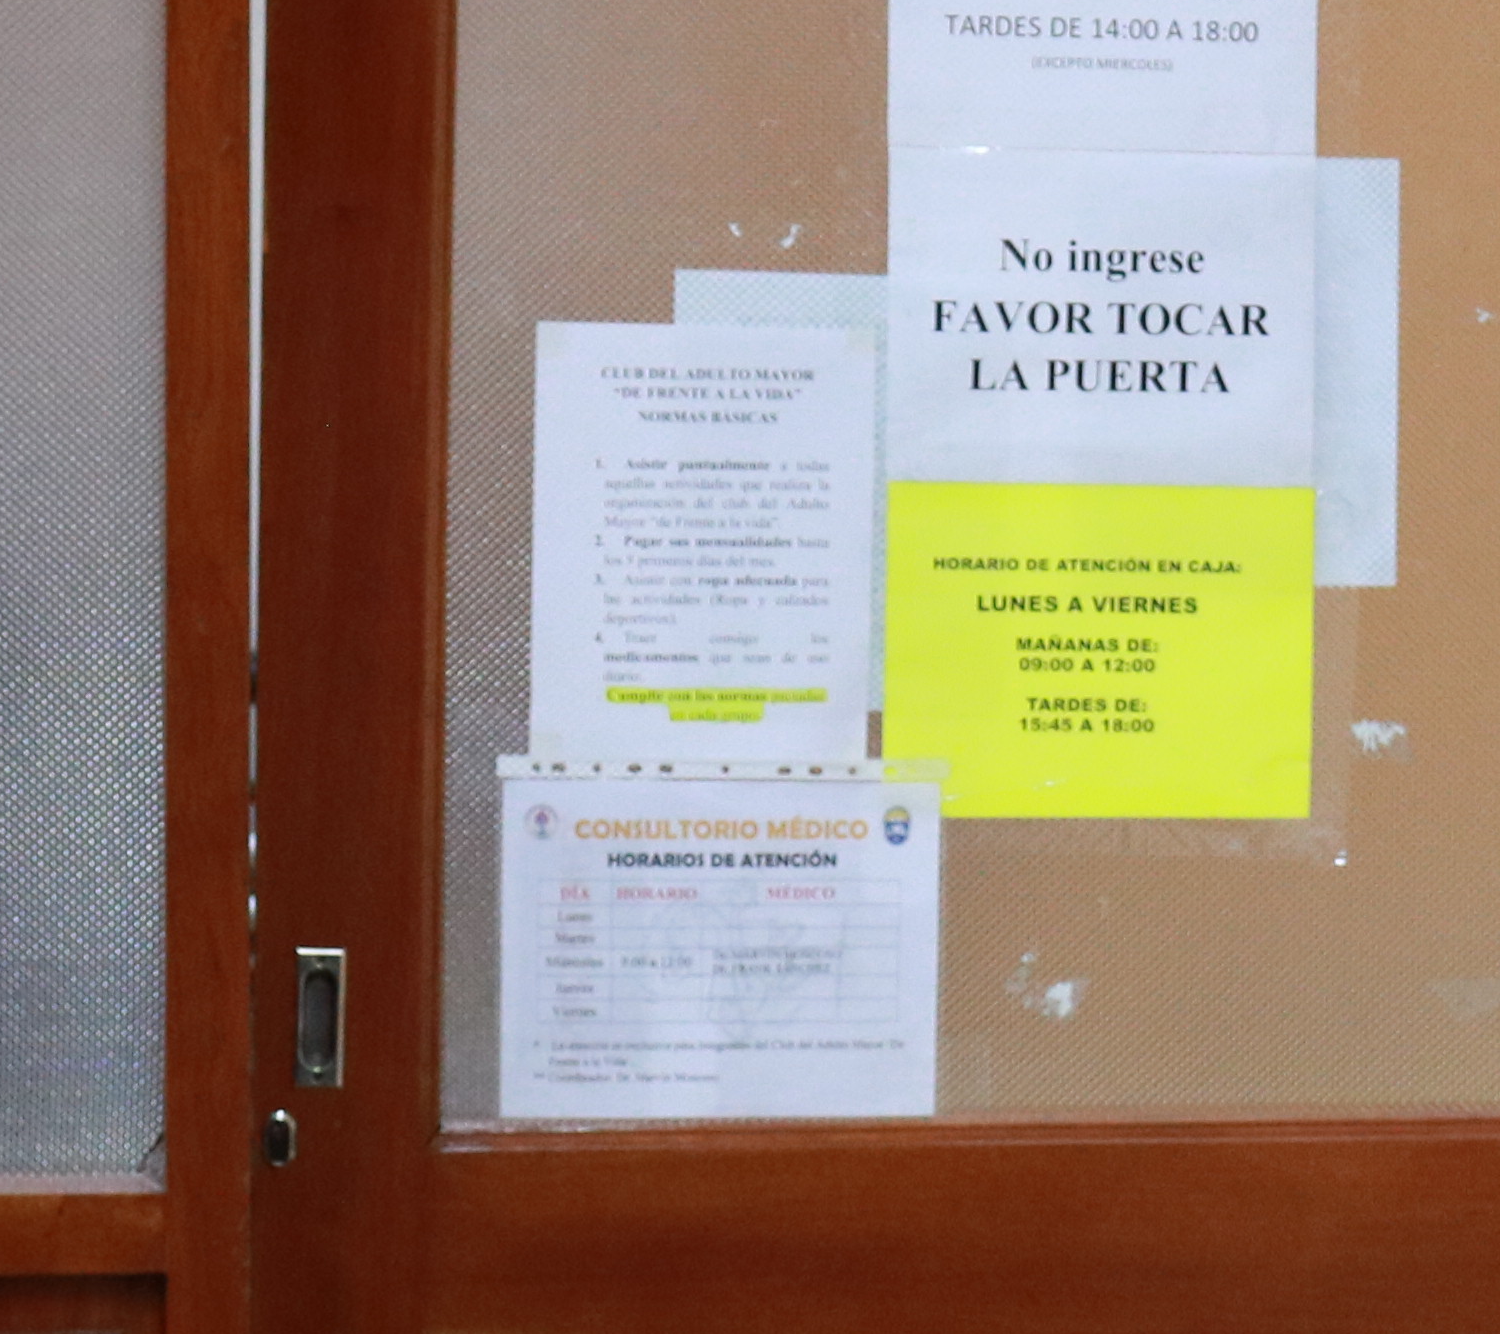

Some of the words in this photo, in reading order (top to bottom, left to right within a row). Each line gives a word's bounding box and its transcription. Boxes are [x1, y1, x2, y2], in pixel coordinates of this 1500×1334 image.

[946, 14, 1041, 37] TARDES
[1050, 17, 1080, 38] DE
[1094, 18, 1159, 40] 14:00
[1167, 20, 1182, 39] A
[1194, 21, 1259, 43] 18:00
[1001, 240, 1052, 270] No
[1070, 241, 1203, 279] ingrese
[935, 301, 1091, 333] FAVOR
[1108, 304, 1267, 335] TOCAR
[972, 360, 1027, 390] LA
[1049, 360, 1227, 392] PUERTA
[934, 558, 1019, 570] HORARIO
[1026, 559, 1048, 571] DE
[1057, 558, 1151, 572] ATENCIÓN
[1158, 561, 1181, 572] EN
[1189, 560, 1239, 573] CAJA:
[978, 596, 1058, 612] LUNES
[1068, 596, 1082, 612] A
[1093, 597, 1197, 613] VIERNES
[1017, 635, 1119, 652] MAÑANAS
[1127, 638, 1158, 652] DE:
[1019, 657, 1074, 671] 09:00
[1082, 659, 1094, 671] A
[1104, 658, 1155, 673] 12:00
[1028, 697, 1107, 712] TARDES
[1115, 699, 1148, 712] DE:
[1021, 718, 1072, 731] 15:45
[1081, 719, 1092, 731] A
[1103, 719, 1154, 732] 18:00
[574, 818, 757, 840] CONSULTORIO
[767, 814, 868, 840] MÉDICO
[608, 853, 703, 867] HORARIOS
[711, 854, 734, 867] DE
[741, 851, 836, 867] ATENCIÓN
